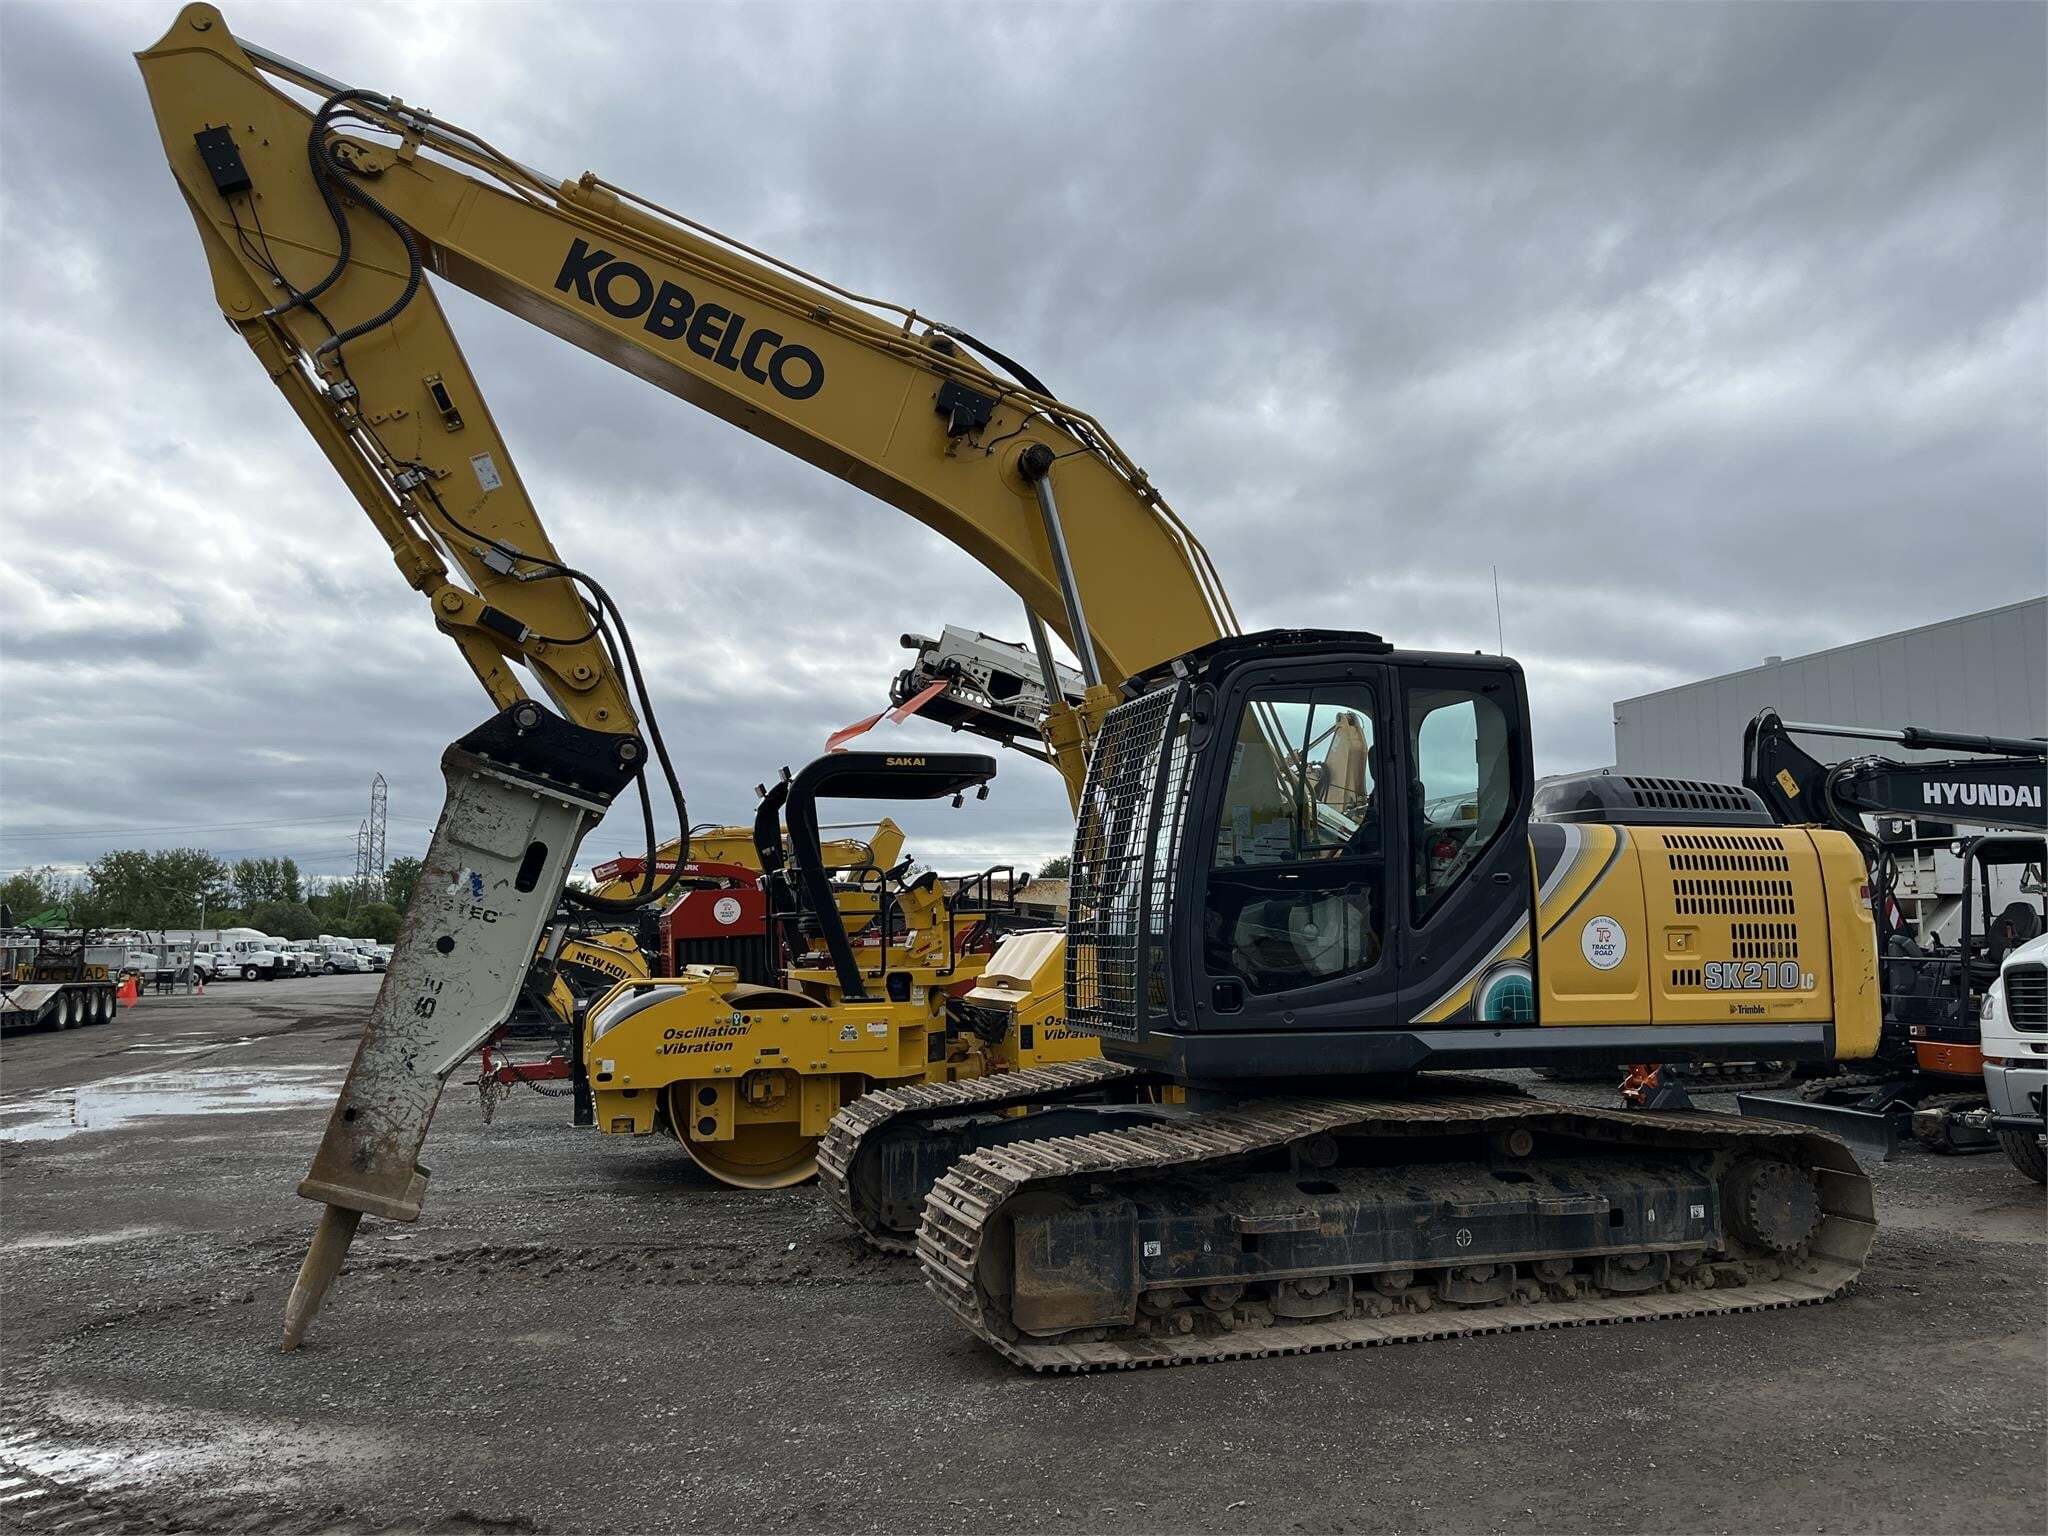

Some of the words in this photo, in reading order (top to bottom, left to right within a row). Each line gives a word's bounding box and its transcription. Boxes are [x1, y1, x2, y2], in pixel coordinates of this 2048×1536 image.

[554, 238, 824, 400] KOBELCO
[886, 757, 926, 766] SAKAI
[1923, 782, 2042, 808] HYUNDAI
[655, 862, 699, 871] MORARK
[576, 951, 605, 968] NEW
[1704, 961, 1800, 990] SK210
[1800, 973, 1814, 990] LC
[1738, 1004, 1765, 1014] Trimble
[663, 1023, 753, 1040] Oscillation/
[663, 1041, 734, 1055] Vibration
